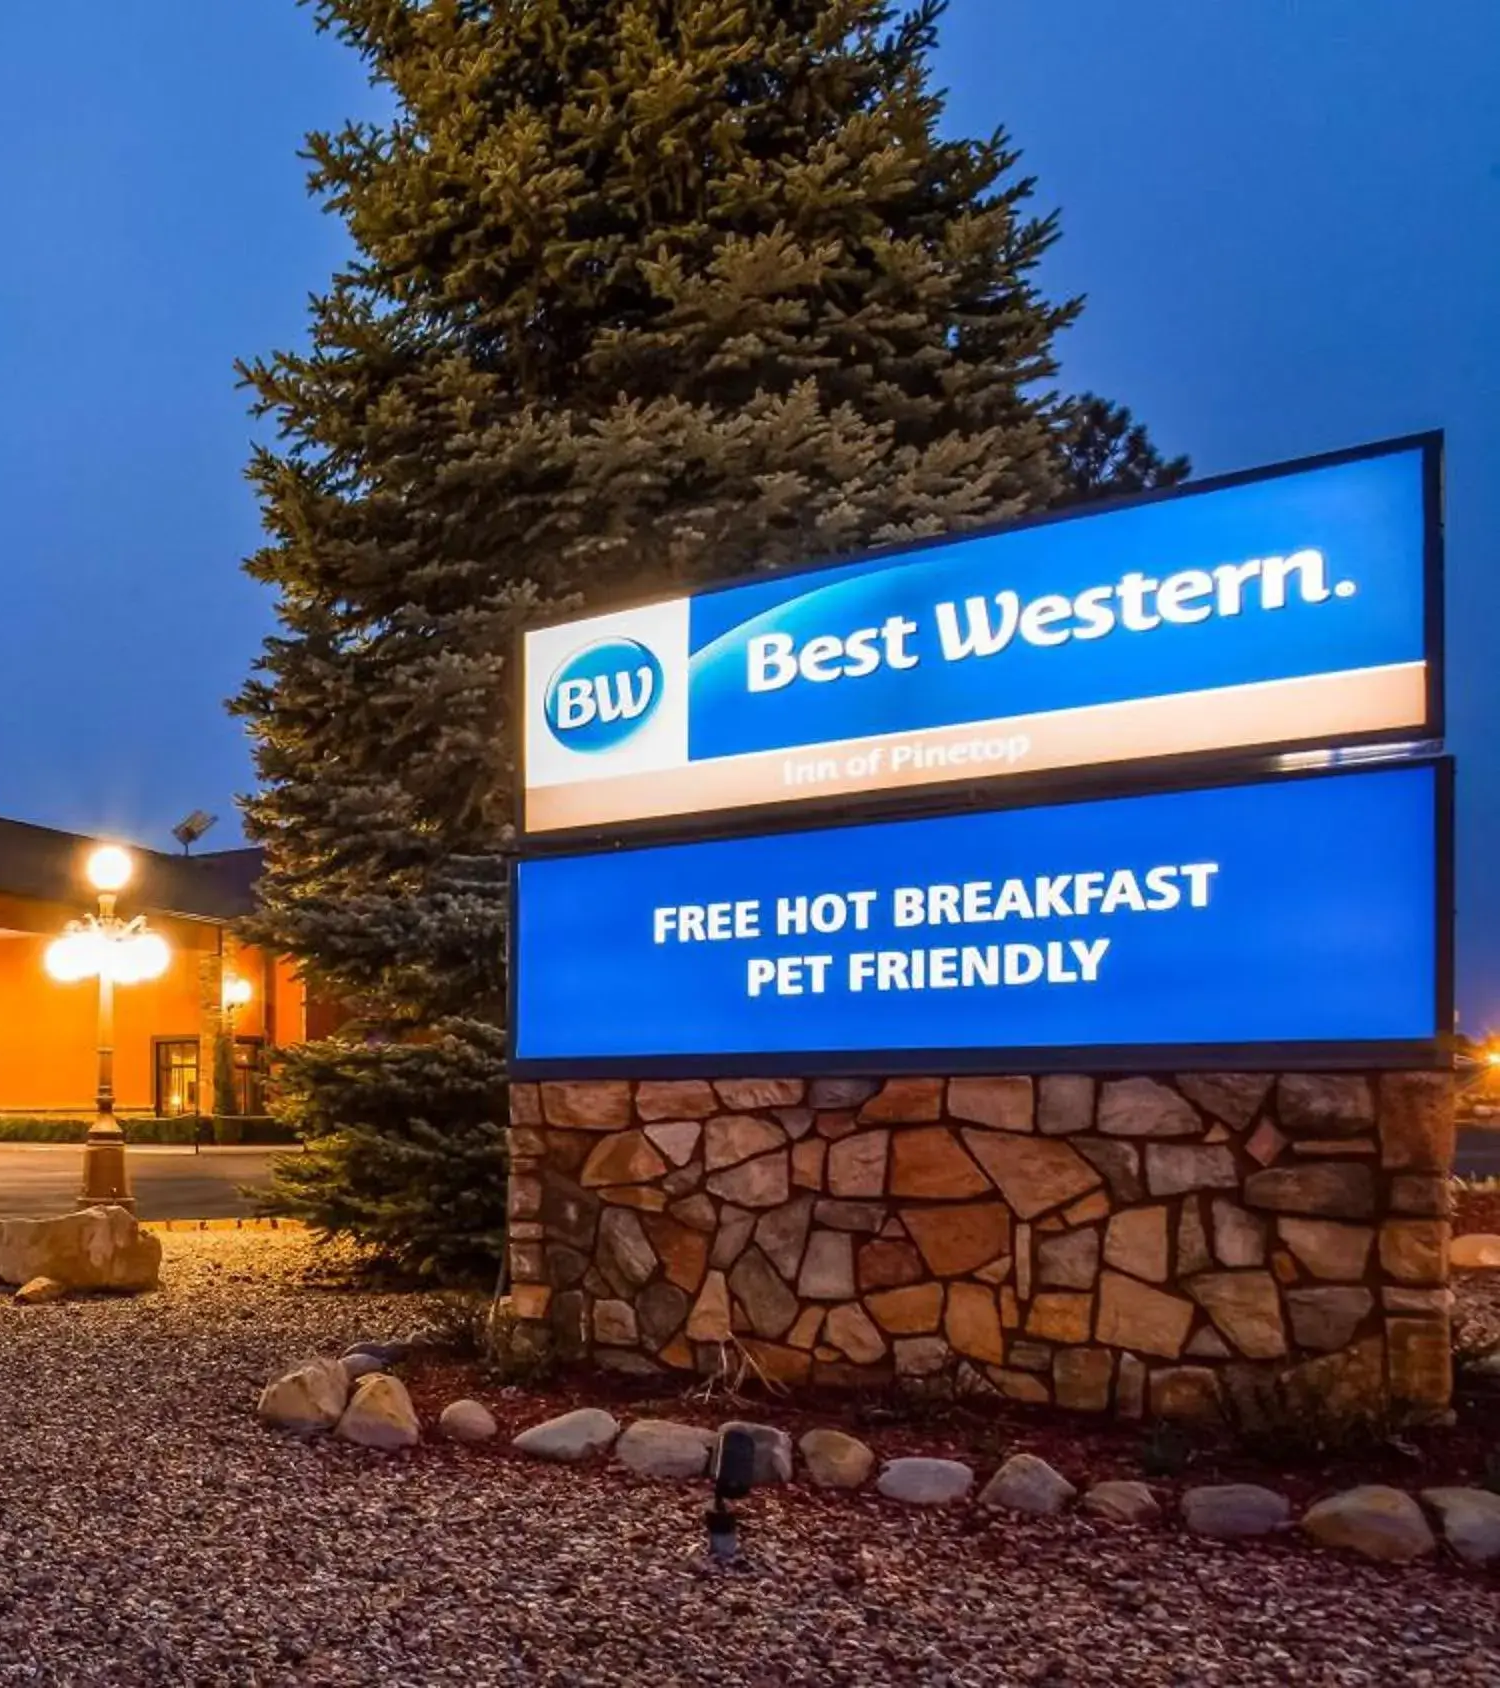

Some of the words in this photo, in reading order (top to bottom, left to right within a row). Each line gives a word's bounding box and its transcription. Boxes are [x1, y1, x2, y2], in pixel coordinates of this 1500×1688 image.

[747, 616, 919, 692] Best
[557, 666, 653, 730] BW
[783, 758, 839, 785] Inn
[845, 748, 883, 777] of
[890, 733, 1032, 772] Pinetop
[654, 900, 760, 944] FREE
[777, 891, 878, 936] HOT
[893, 862, 1220, 928] BREAKFAST
[747, 954, 833, 998] PET
[848, 938, 1111, 992] FRIENDLY
